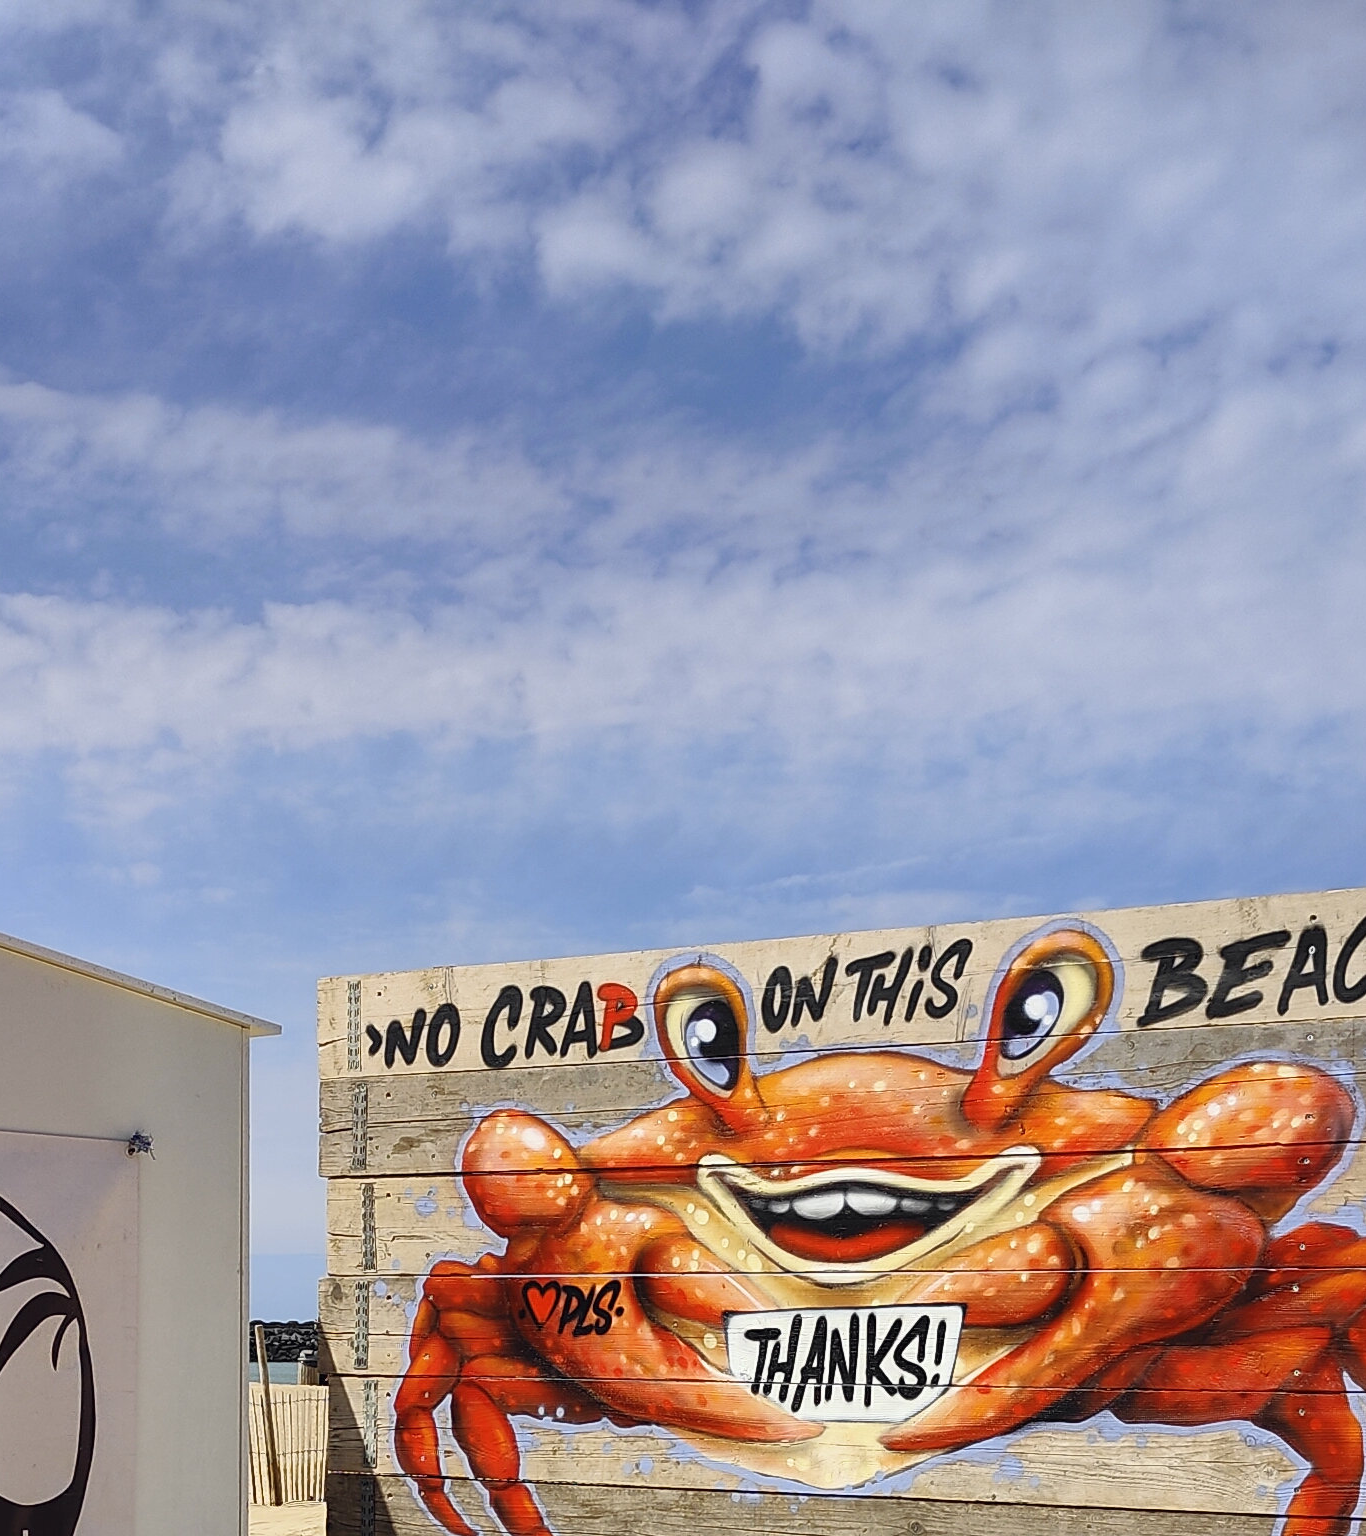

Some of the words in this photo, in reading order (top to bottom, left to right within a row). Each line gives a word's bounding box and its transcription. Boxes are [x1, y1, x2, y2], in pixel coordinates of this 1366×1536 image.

[481, 981, 645, 1068] CRAB
[762, 955, 838, 1033] ON
[744, 1312, 948, 1412] THANKS!
